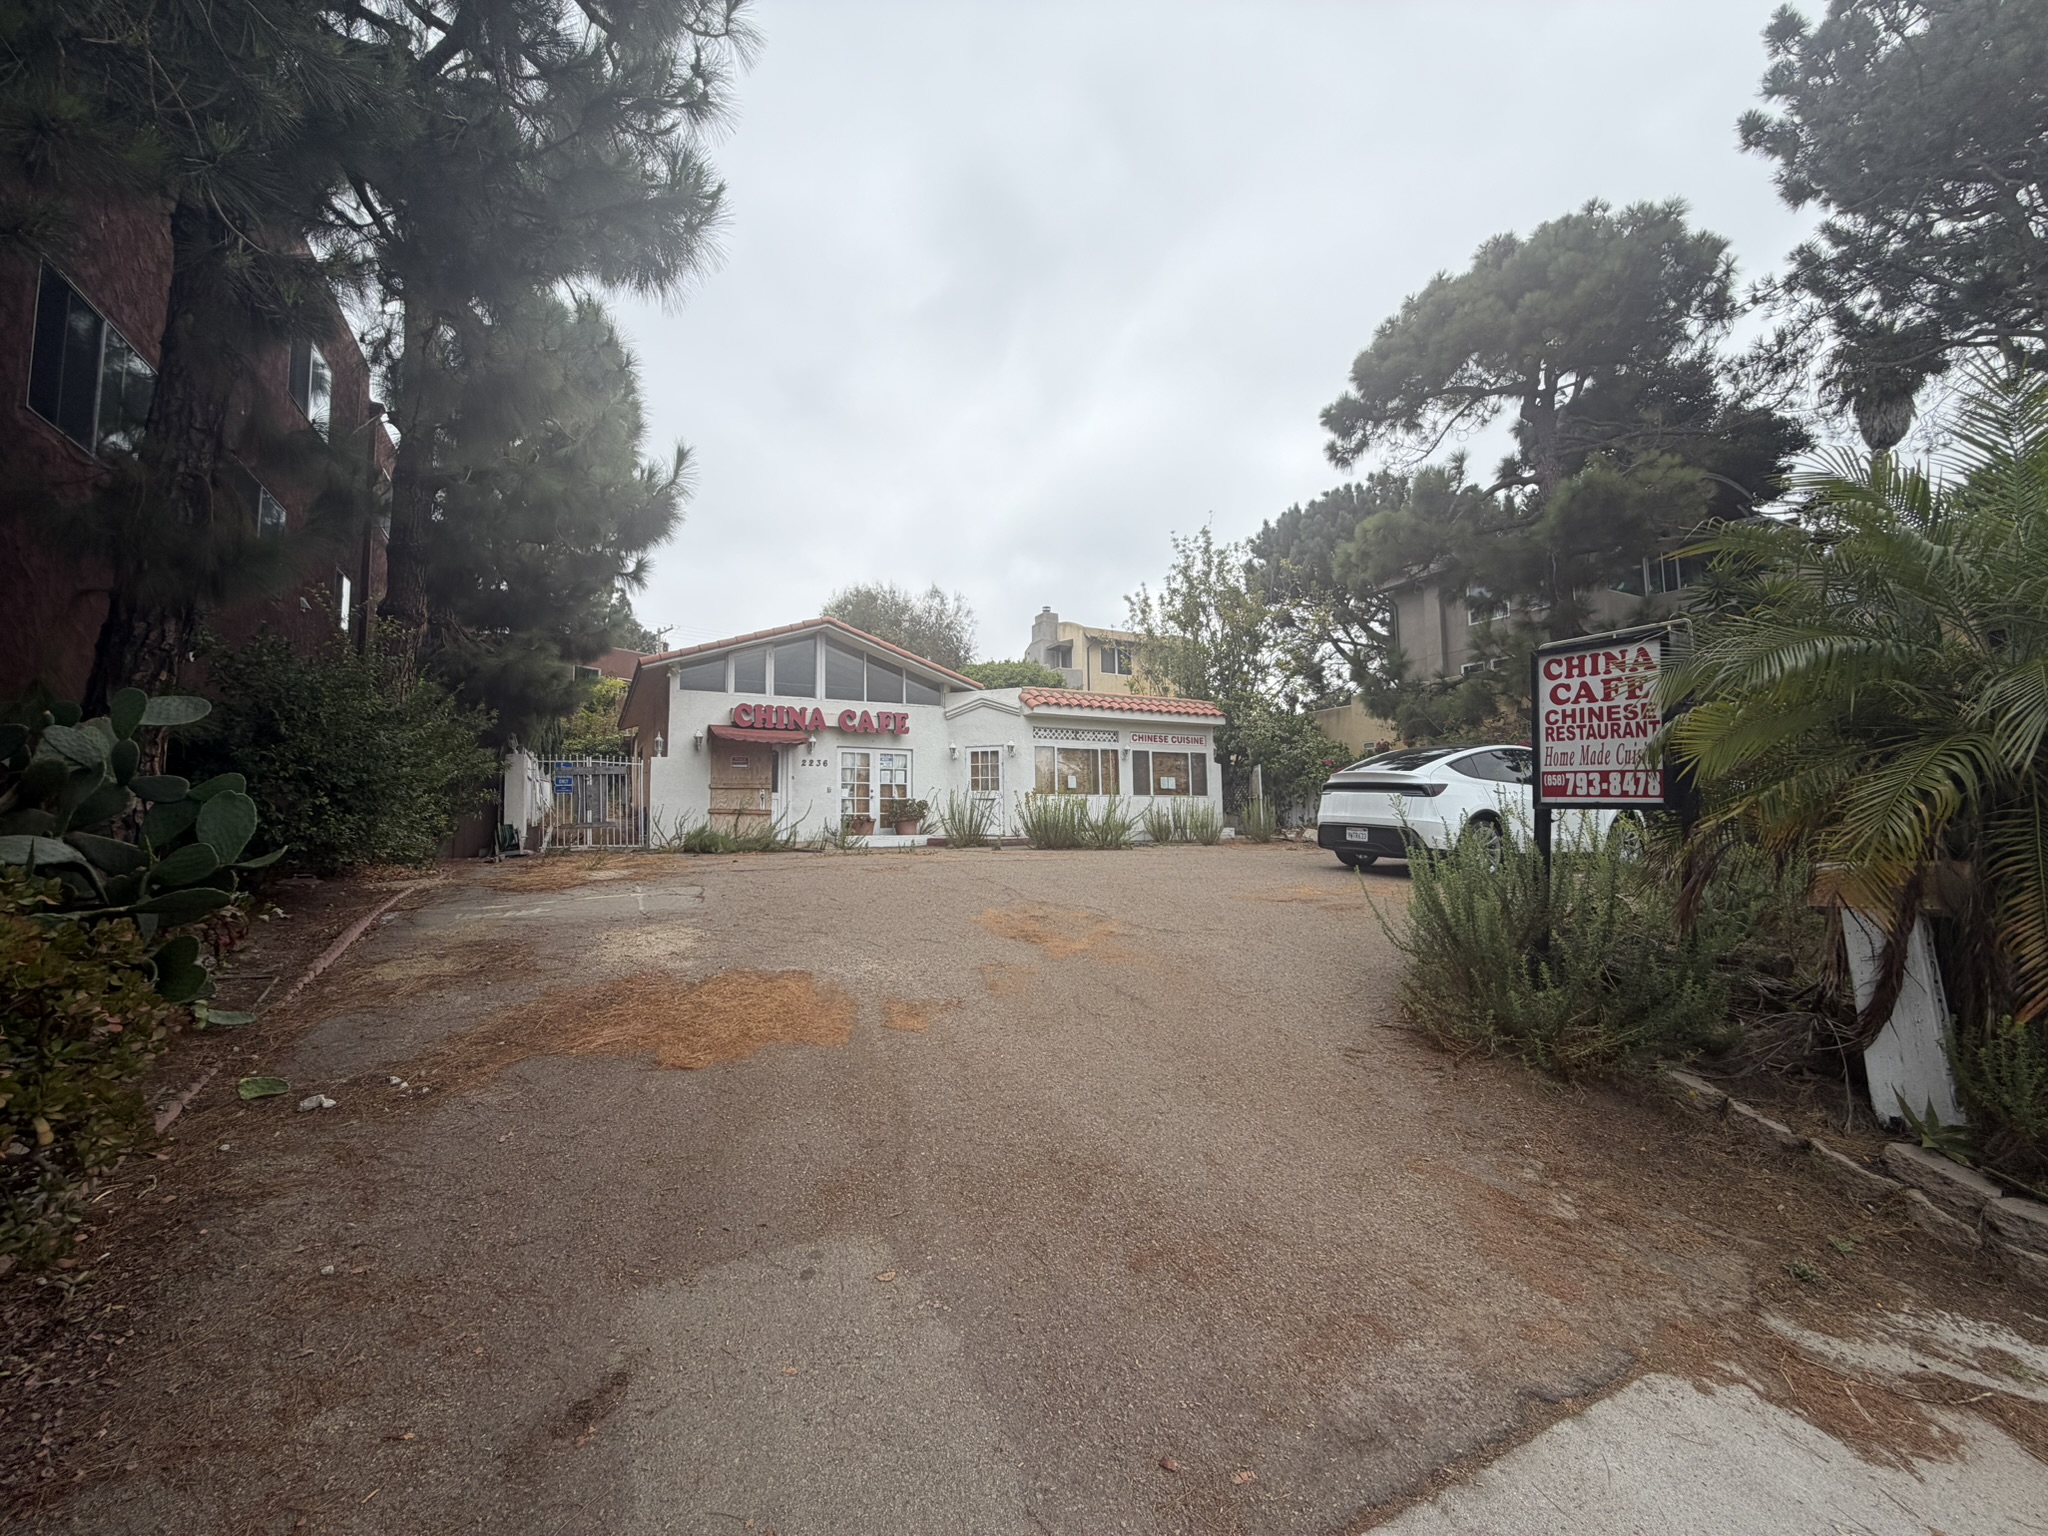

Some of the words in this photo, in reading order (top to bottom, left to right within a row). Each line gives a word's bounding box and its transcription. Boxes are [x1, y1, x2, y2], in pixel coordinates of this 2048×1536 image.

[1543, 646, 1657, 681] CHINA
[1549, 676, 1651, 705] CAFE
[733, 703, 829, 731] CHINA
[838, 709, 910, 735] CAFE
[1545, 702, 1657, 725] CHINESE
[1131, 733, 1169, 744] CHINESE
[1170, 735, 1205, 745] CUISINE
[1545, 719, 1661, 742] RESTAURANT
[800, 758, 828, 767] 2236
[1544, 746, 1576, 767] Home
[1579, 742, 1611, 766] Made
[1565, 771, 1661, 796] 793-8478
